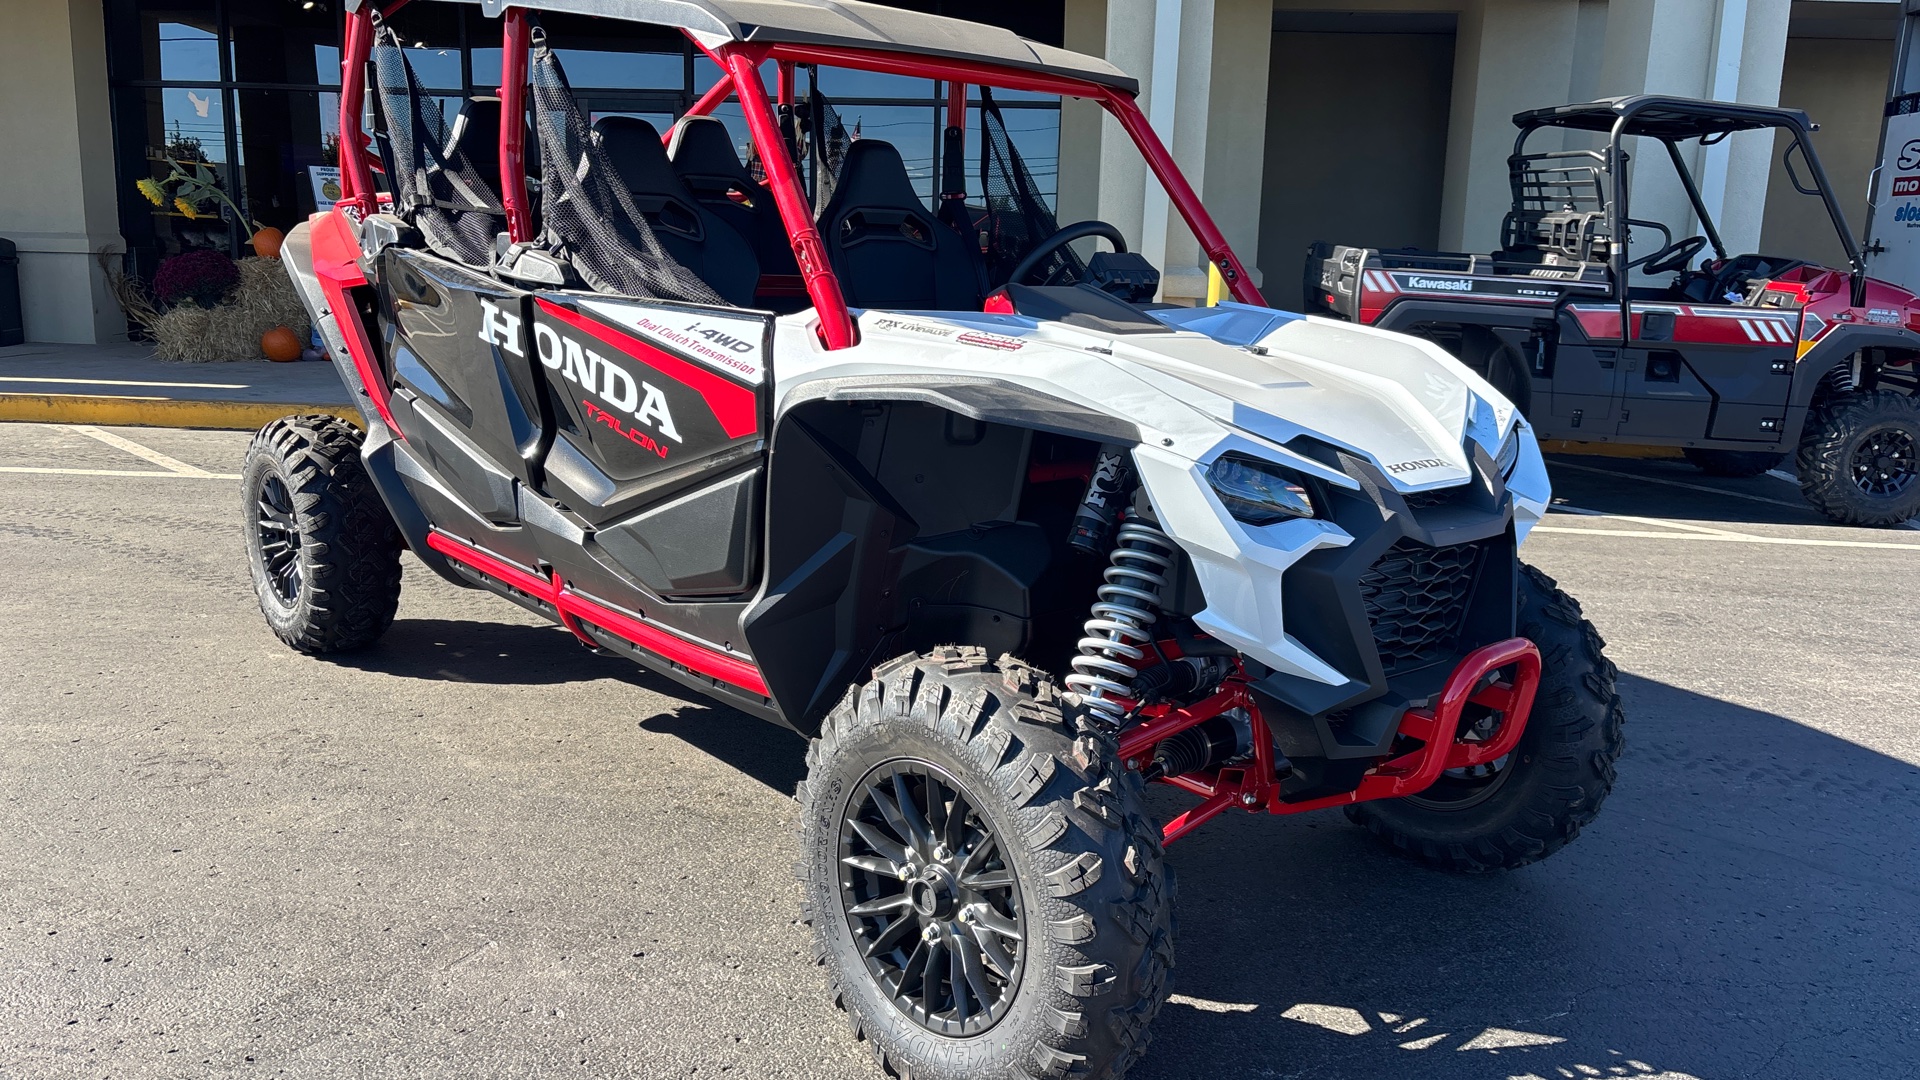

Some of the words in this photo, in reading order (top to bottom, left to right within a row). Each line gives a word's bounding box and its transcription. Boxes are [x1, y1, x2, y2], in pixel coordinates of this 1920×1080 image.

[1408, 276, 1473, 291] Kawasaki
[636, 318, 662, 332] Dual
[658, 327, 690, 346] Clutch
[688, 340, 756, 376] Transmission
[684, 322, 755, 353] i-4WD
[479, 300, 683, 443] HONDA
[582, 400, 669, 459] TALON
[1085, 451, 1124, 509] FOX
[1386, 458, 1454, 473] HONDA
[888, 1016, 994, 1071] KENDA
